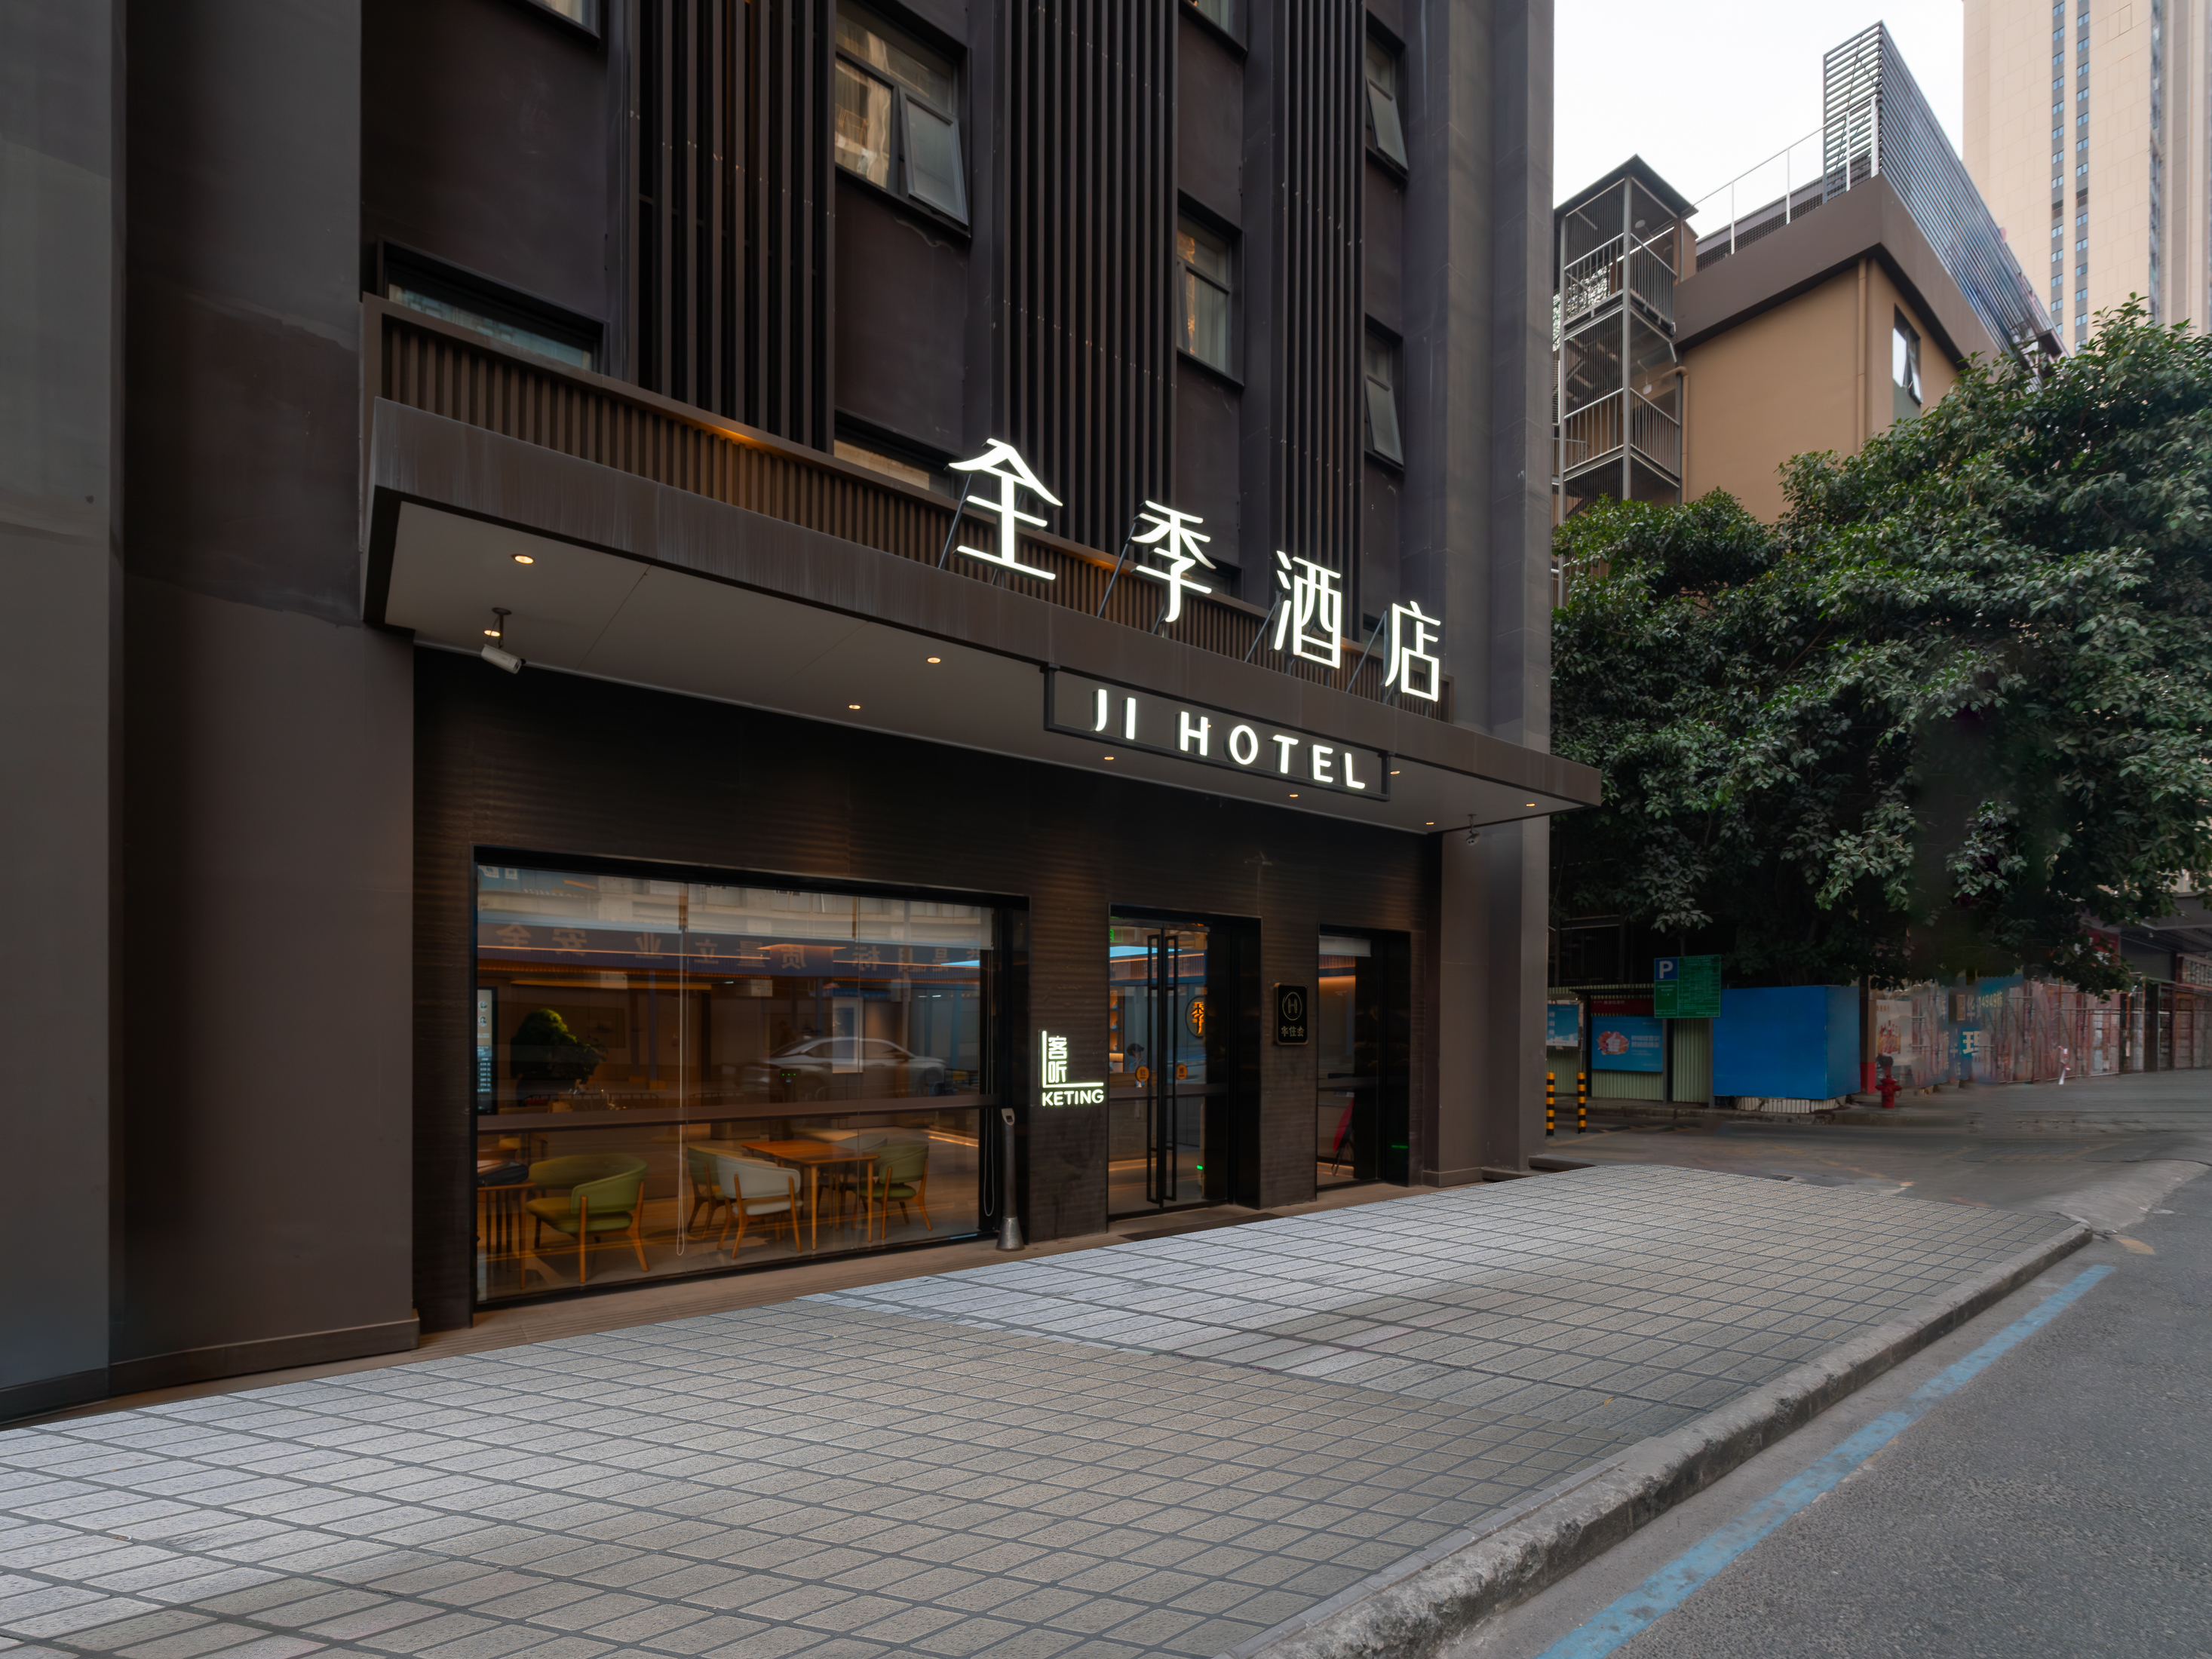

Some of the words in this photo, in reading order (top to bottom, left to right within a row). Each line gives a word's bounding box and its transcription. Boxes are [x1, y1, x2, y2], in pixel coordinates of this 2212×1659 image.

[948, 437, 1440, 702] 全季酒店
[1094, 688, 1137, 740] JI
[1179, 711, 1366, 790] HOTEL
[1659, 960, 1674, 979] P
[1281, 1026, 1305, 1038] 华住会
[1042, 1088, 1104, 1107] KETING
